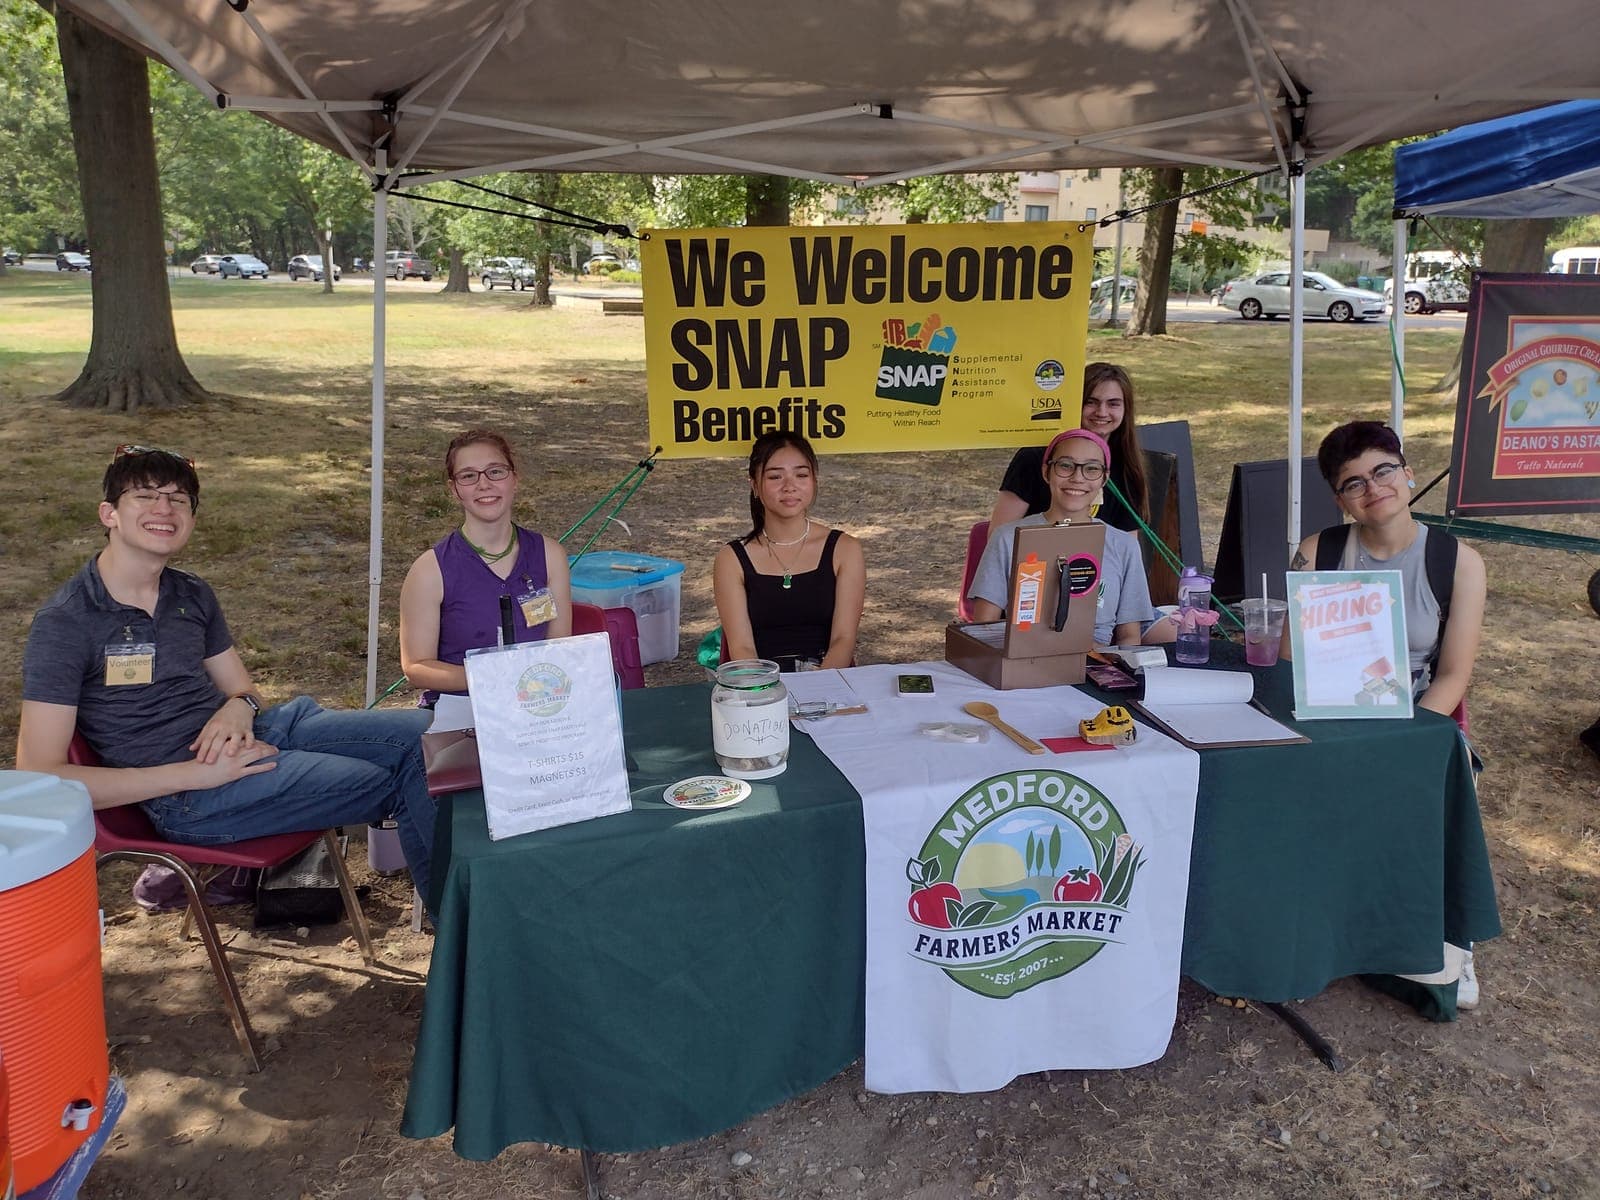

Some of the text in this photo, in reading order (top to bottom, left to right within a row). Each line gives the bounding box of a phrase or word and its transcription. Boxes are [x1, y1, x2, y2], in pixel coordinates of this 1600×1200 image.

[665, 235, 1073, 307] We Welcome
[671, 317, 850, 392] SNAP
[953, 354, 1023, 364] Supplemental
[1504, 349, 1540, 374] ORIGINAL
[1540, 344, 1580, 356] GOURMET
[877, 364, 948, 388] SNAP
[953, 367, 996, 375] Nutrition
[952, 378, 1006, 387] Assistance
[952, 390, 994, 399] Program
[1031, 398, 1062, 408] USDA
[673, 397, 846, 442] Benefits
[867, 408, 941, 418] Putting Healthy Food
[893, 419, 915, 427] Within
[1502, 435, 1559, 450] DEANO'S
[1517, 457, 1584, 470] Tutto Naturale
[1301, 591, 1383, 630] HIRING
[109, 658, 151, 668] Volunteer
[528, 751, 585, 768] T-SHIRTS $15
[530, 766, 586, 784] MAGNETS $3
[938, 774, 1109, 849] MEDFORD
[914, 911, 1122, 959] FARMERS MARKET
